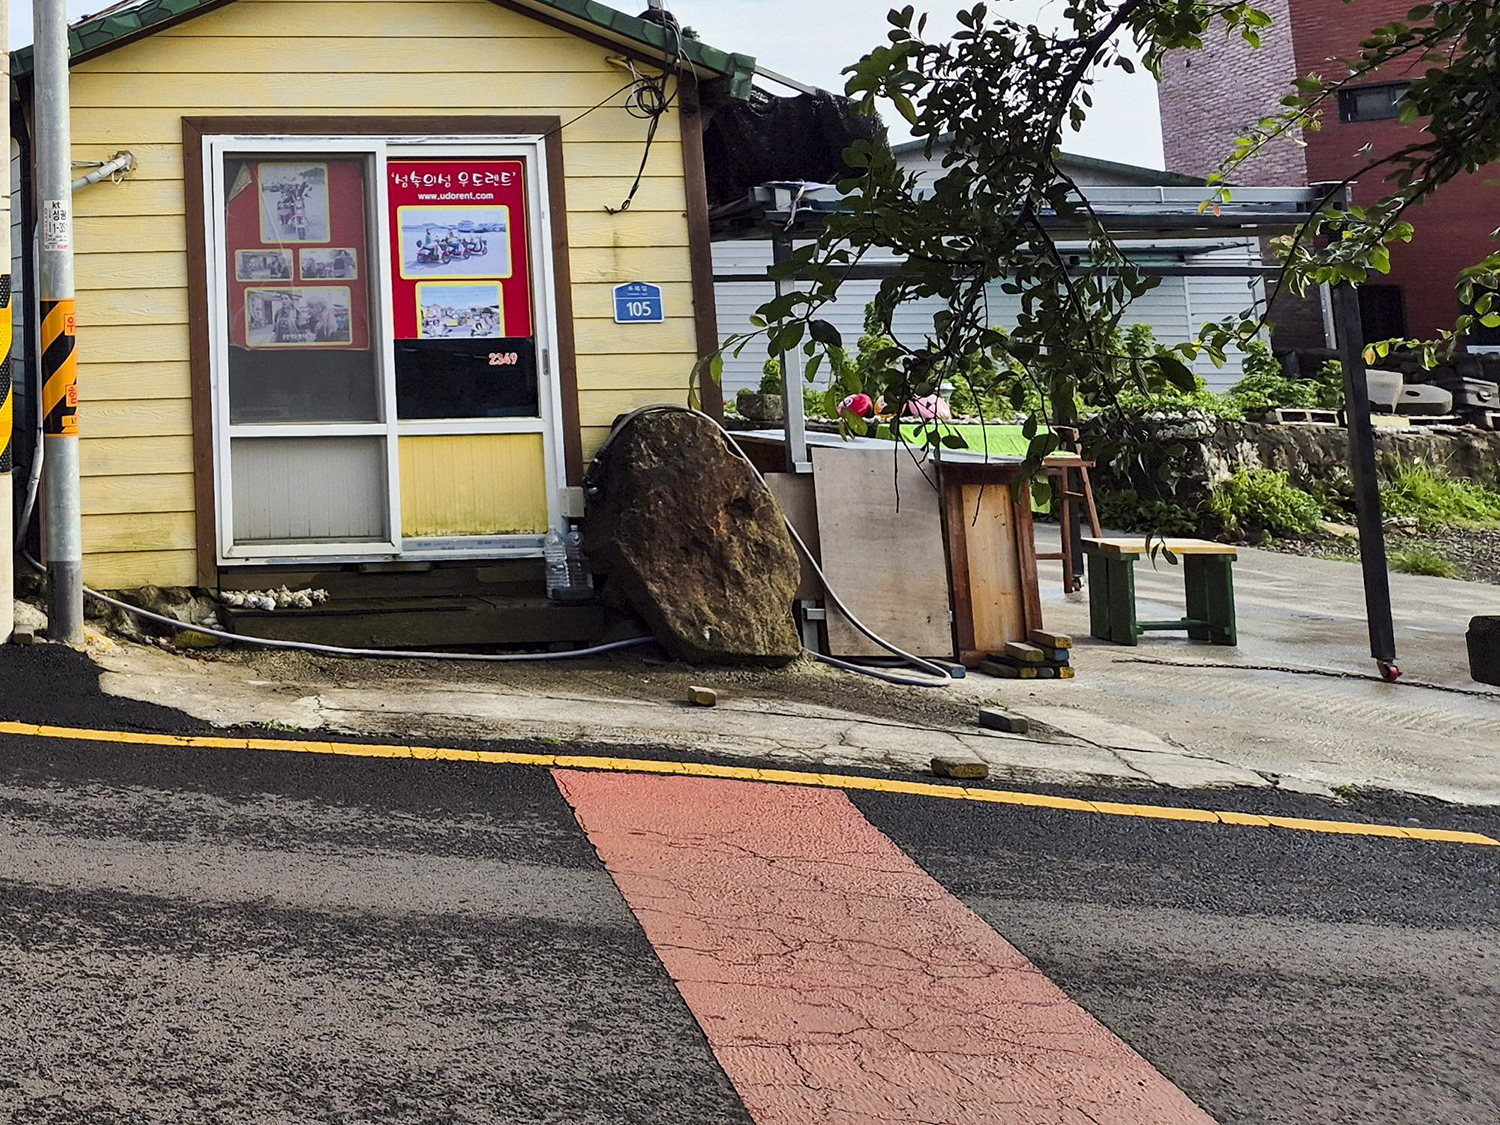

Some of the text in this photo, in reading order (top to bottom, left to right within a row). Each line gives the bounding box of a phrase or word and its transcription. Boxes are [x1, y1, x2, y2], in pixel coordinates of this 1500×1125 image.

[417, 192, 494, 201] www.udorent.com
[52, 201, 61, 209] kt
[625, 301, 652, 317] 105
[488, 352, 518, 365] 2349
